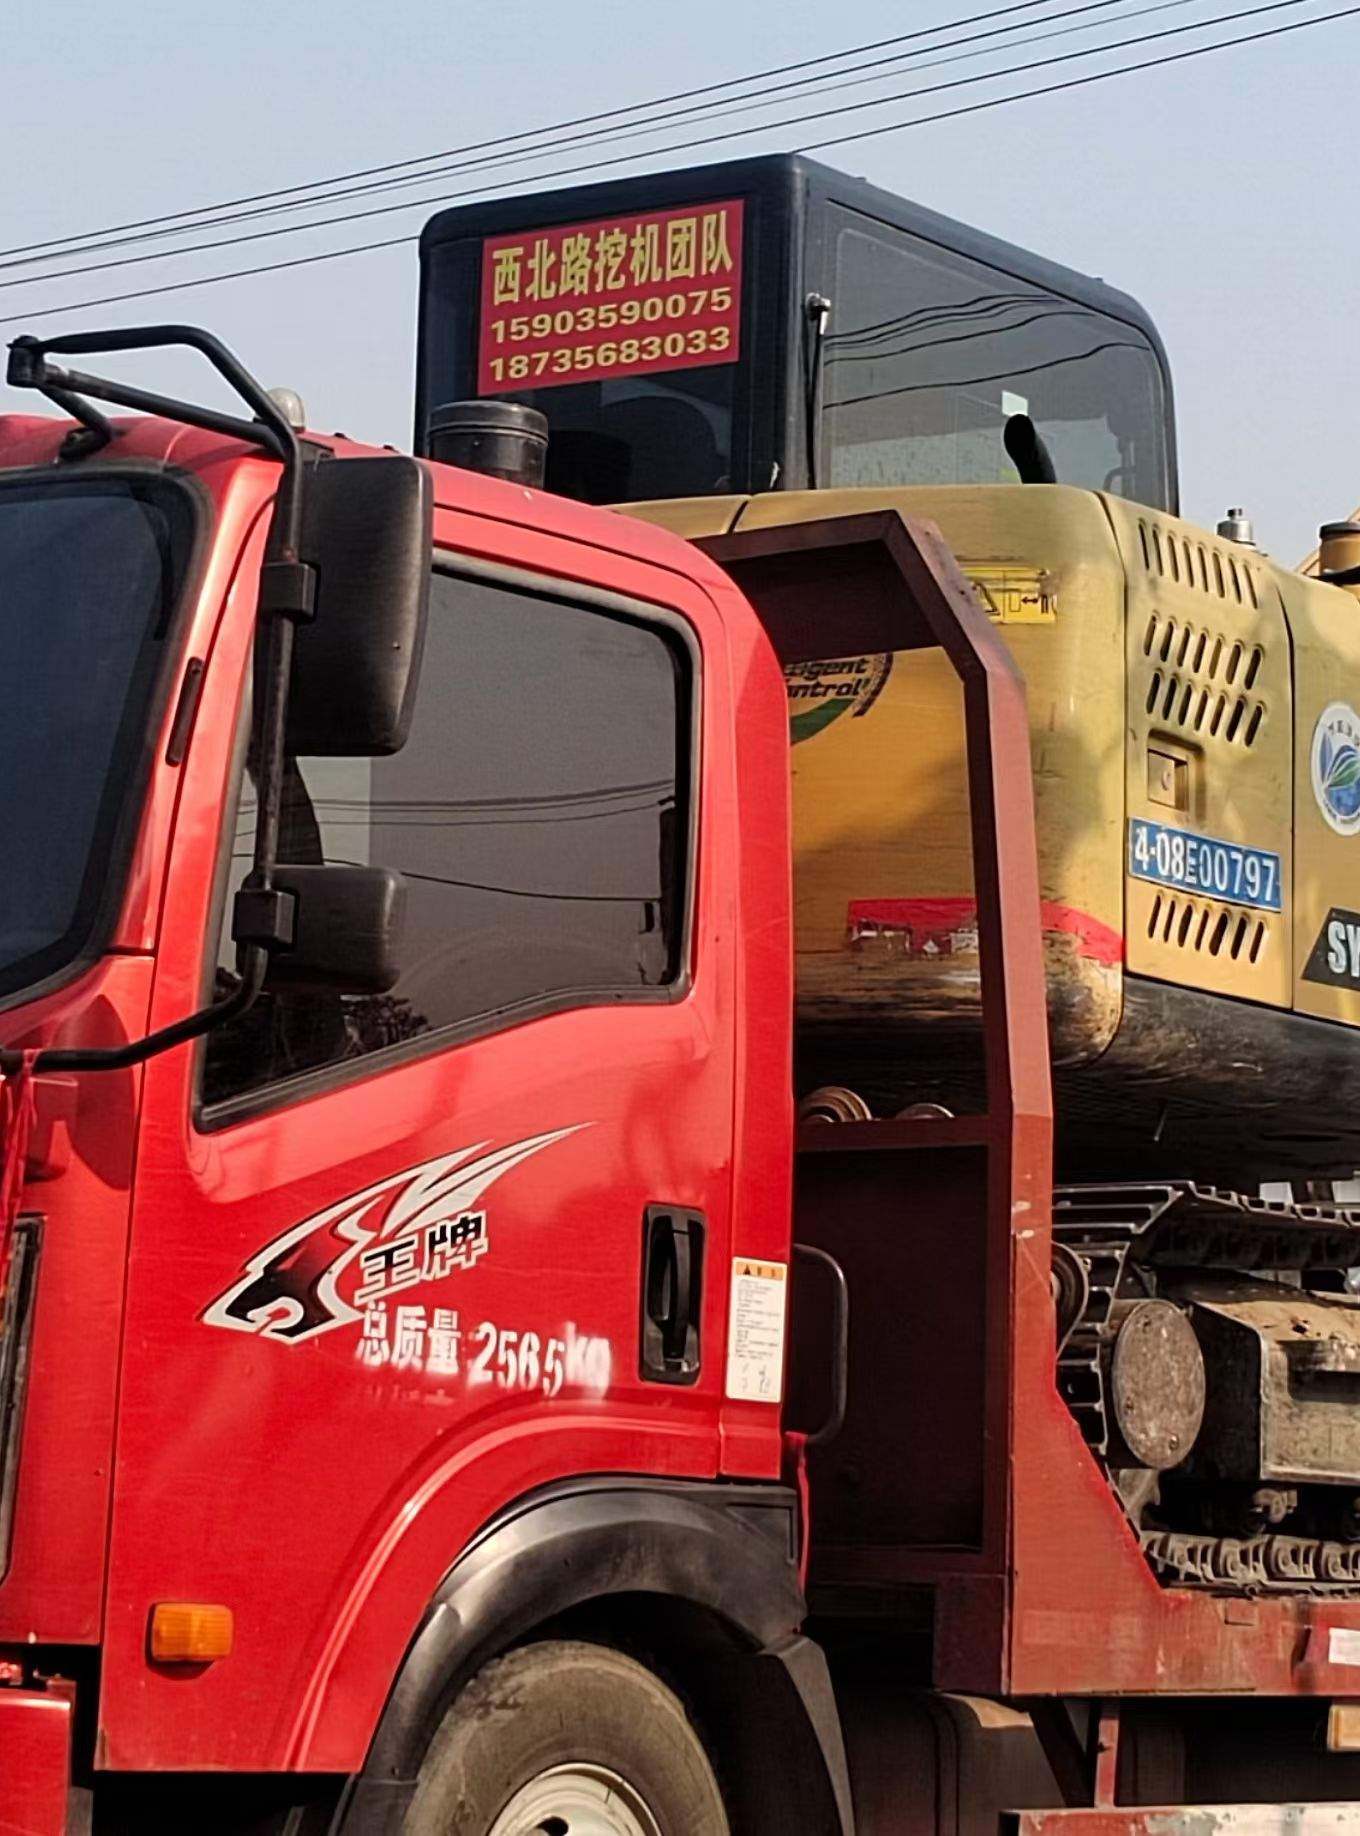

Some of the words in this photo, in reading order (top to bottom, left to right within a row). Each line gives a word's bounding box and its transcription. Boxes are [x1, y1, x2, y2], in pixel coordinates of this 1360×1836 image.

[492, 210, 733, 305] 西北路挖机团队
[491, 287, 732, 343] 15903590075
[489, 326, 730, 382] 18735683033
[1134, 826, 1276, 902] 4-08E00797
[353, 1207, 489, 1308] 王牌
[354, 1300, 461, 1376] 总质量
